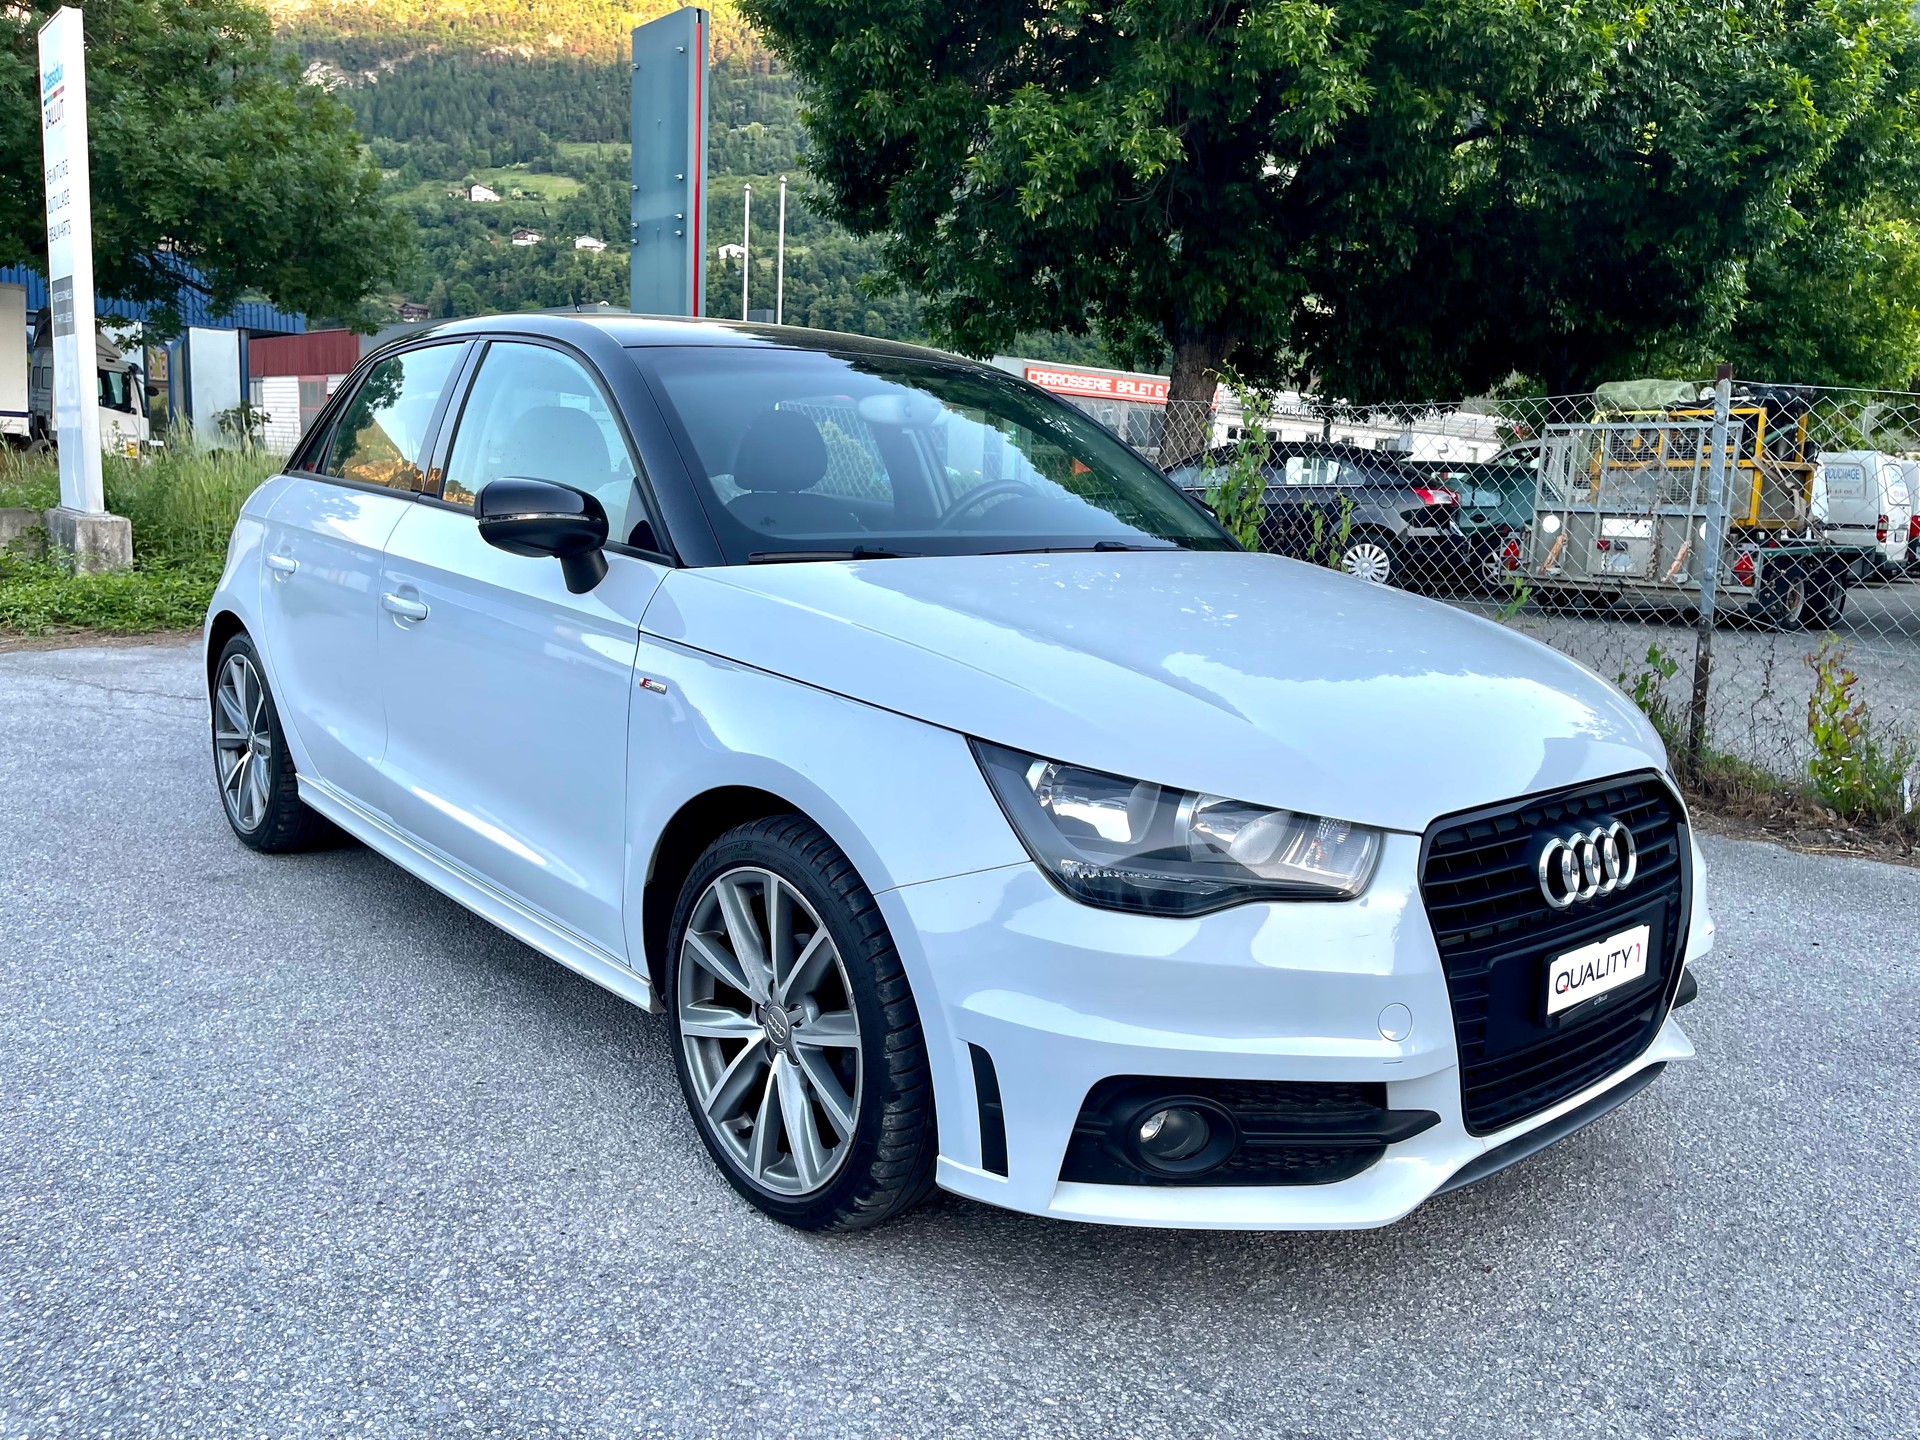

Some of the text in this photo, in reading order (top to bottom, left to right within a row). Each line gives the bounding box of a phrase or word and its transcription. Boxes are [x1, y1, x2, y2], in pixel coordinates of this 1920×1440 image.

[46, 159, 69, 186] PEINTURE
[48, 188, 70, 214] OUTILLAGE
[1027, 369, 1112, 392] CARROSSERIE
[1116, 379, 1153, 396] BALET
[1155, 384, 1164, 397] &
[1555, 942, 1642, 995] QUALITY 1
